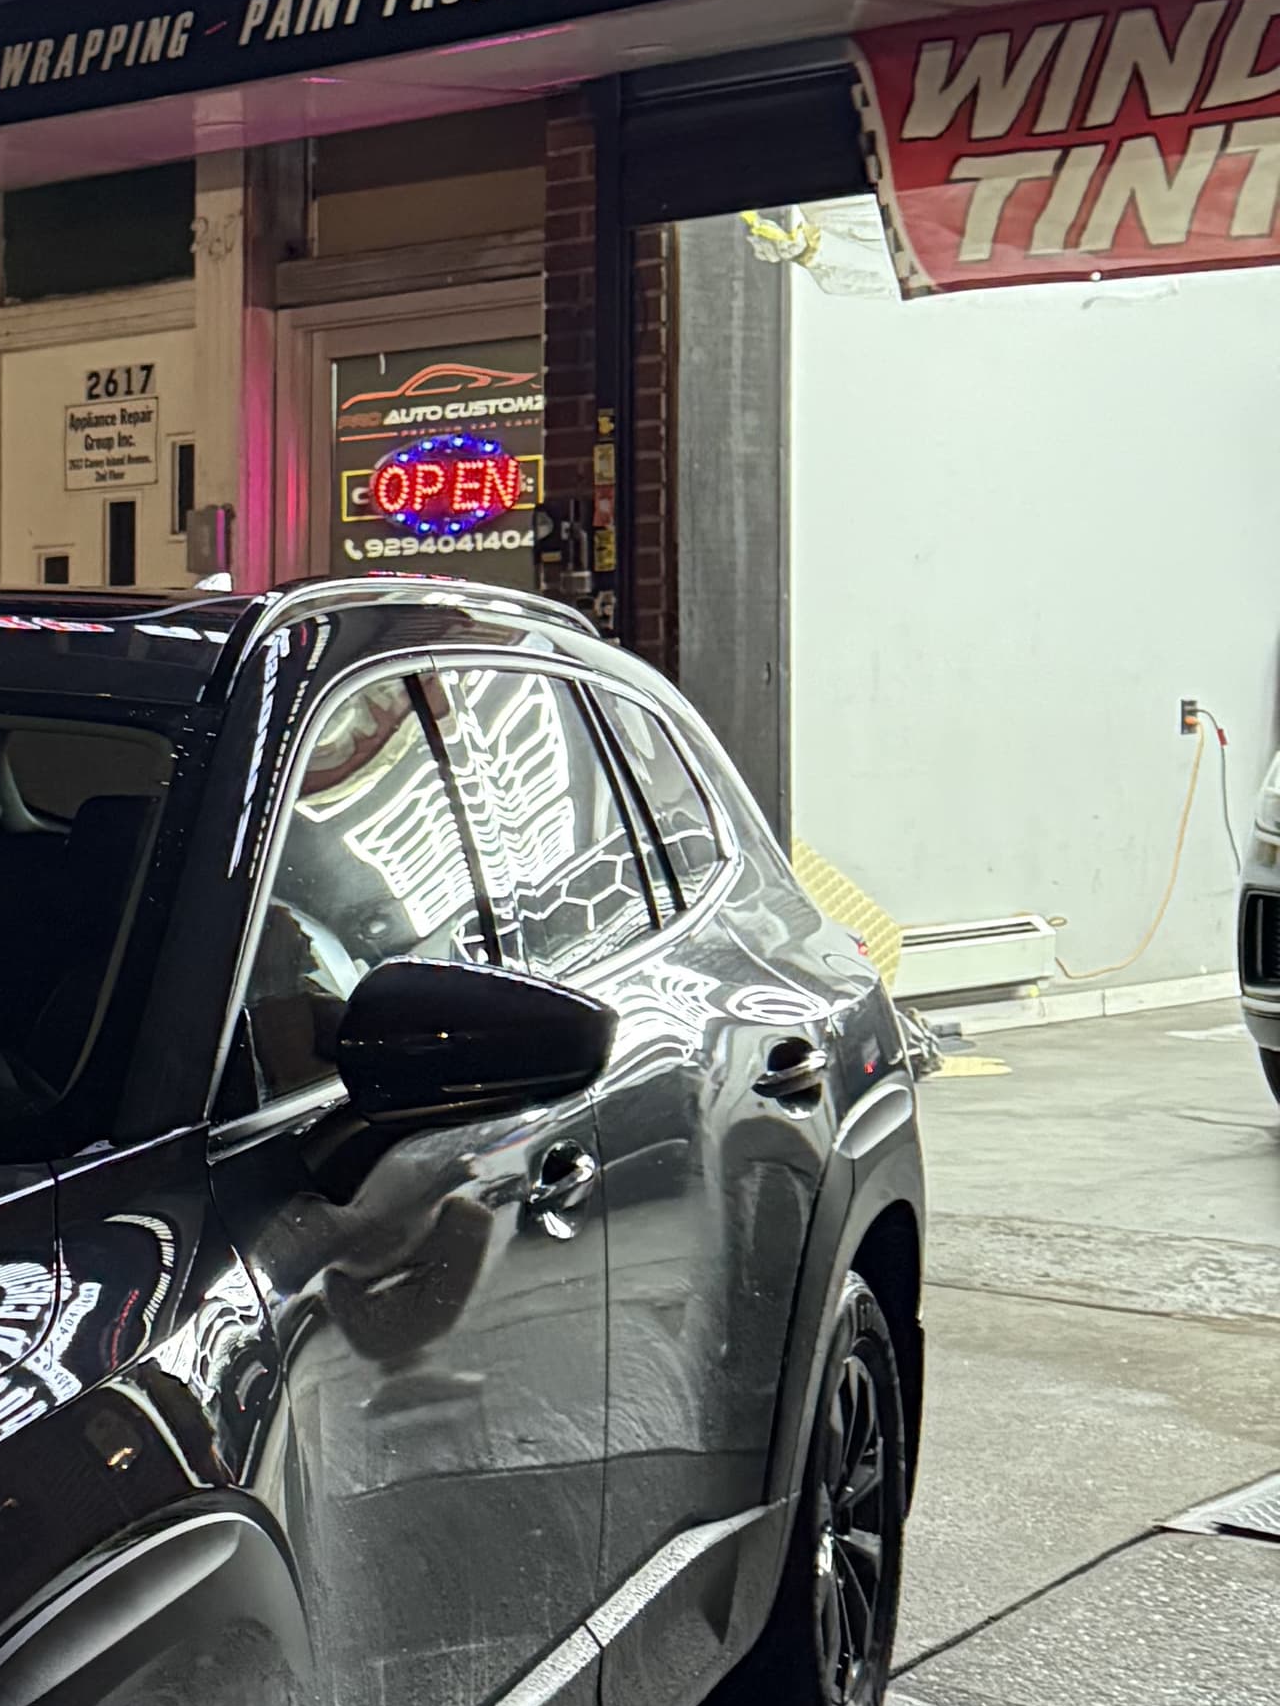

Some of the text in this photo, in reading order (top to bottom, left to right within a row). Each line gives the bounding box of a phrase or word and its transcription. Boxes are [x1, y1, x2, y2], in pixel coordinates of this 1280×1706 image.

[949, 115, 1280, 263] TINT
[86, 363, 155, 401] 2617
[69, 405, 154, 432] Appliance Repair
[383, 405, 441, 425] AUTO
[84, 430, 136, 453] Group Inc.
[376, 456, 519, 513] OPEN
